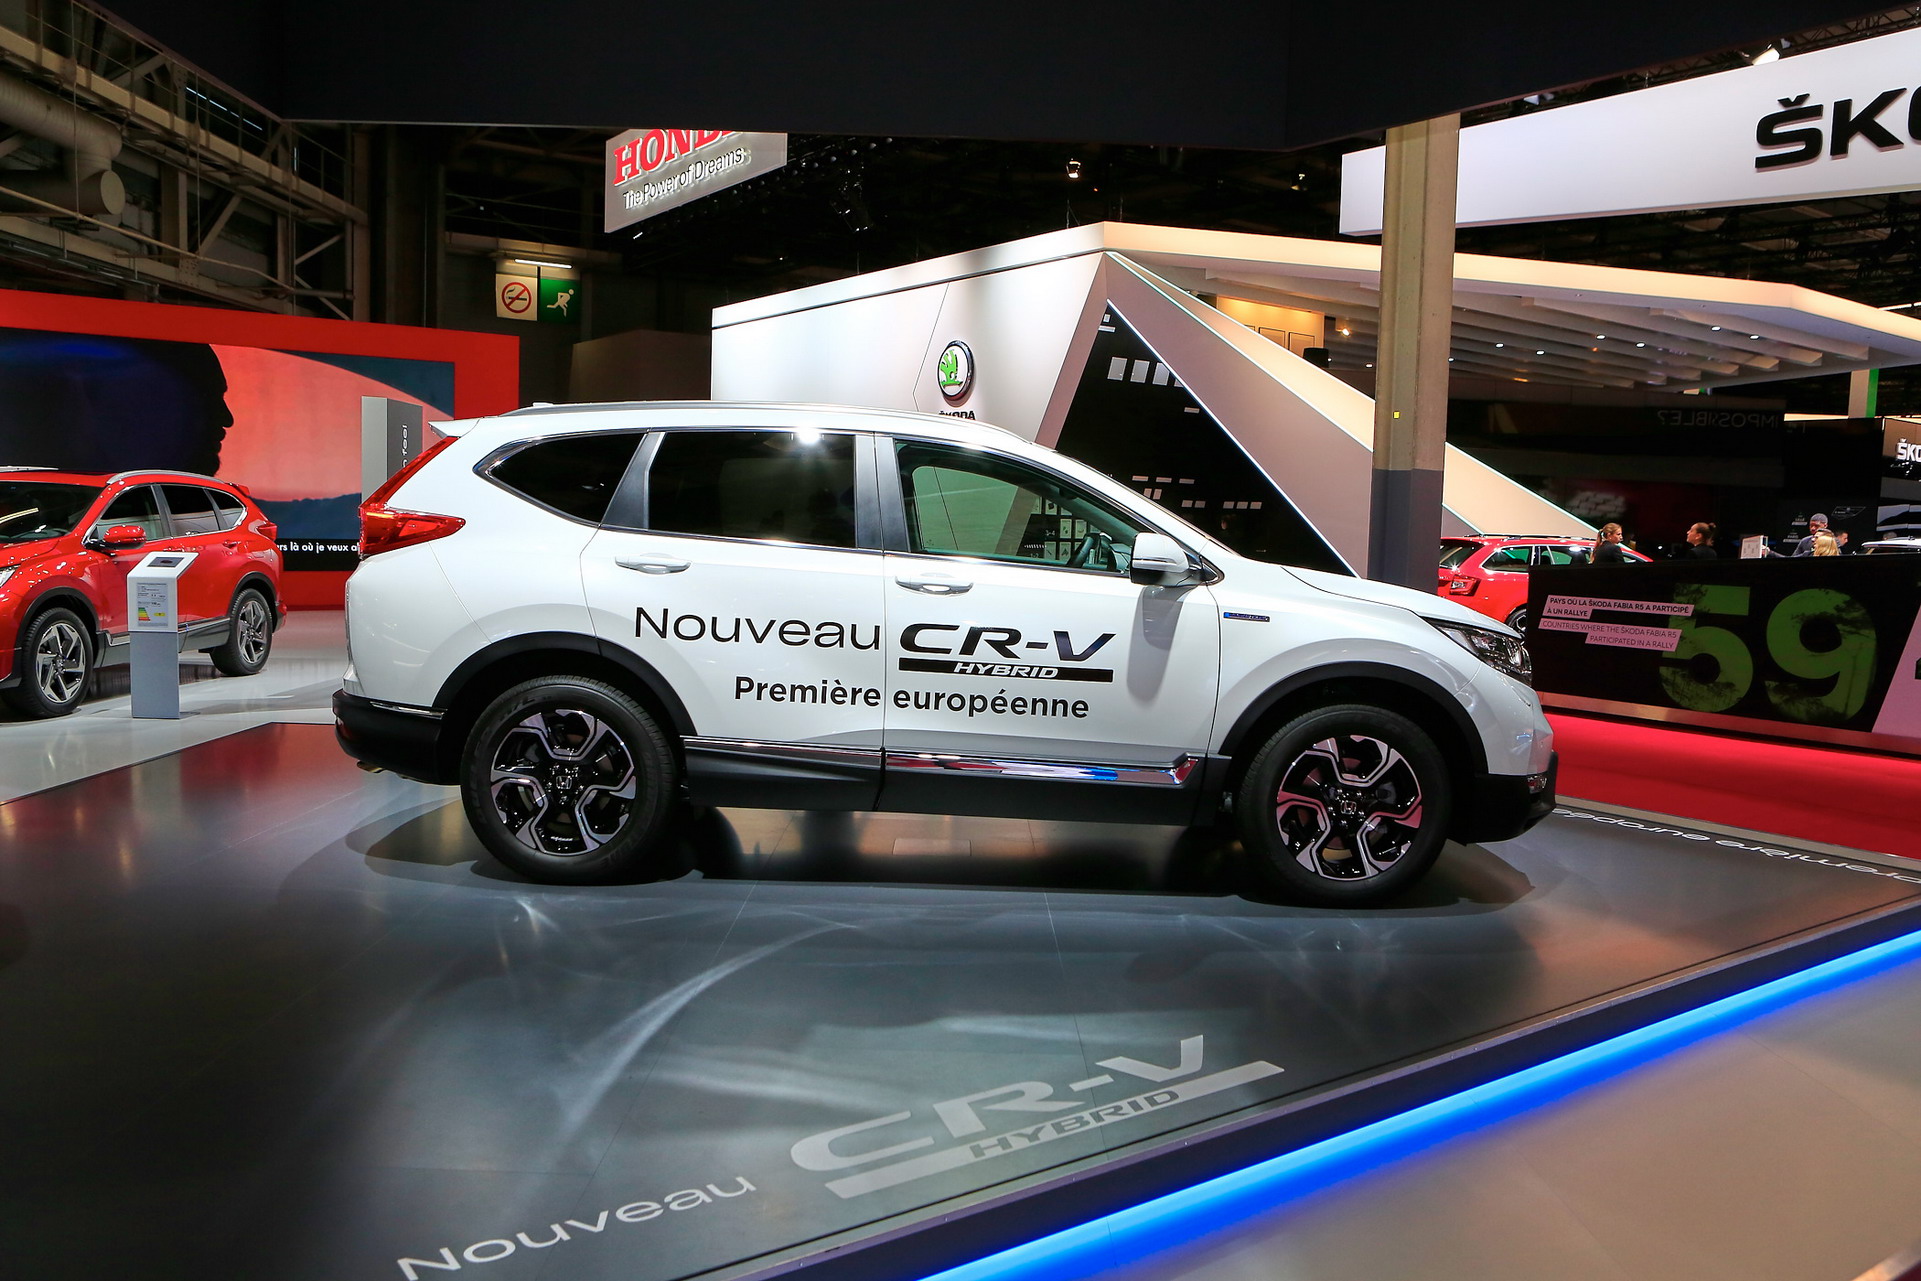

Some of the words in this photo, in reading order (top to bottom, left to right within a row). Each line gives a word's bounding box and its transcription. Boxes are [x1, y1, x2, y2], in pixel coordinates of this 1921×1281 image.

[1755, 86, 1921, 169] ŠK
[613, 129, 742, 185] HON
[623, 188, 643, 209] The
[643, 174, 679, 202] Power
[680, 163, 696, 186] of
[694, 147, 746, 181] Dreams
[290, 541, 299, 551] là
[302, 542, 313, 551] où
[316, 542, 325, 554] je
[1542, 621, 1579, 630] COUNTRIES
[1581, 624, 1605, 632] WHERE
[1620, 626, 1645, 635] ŠKODA
[1646, 629, 1666, 637] FABIA
[1550, 597, 1566, 605] PAYS
[1588, 599, 1612, 608] ŠKODA
[1613, 602, 1633, 610] FABIA
[1652, 604, 1689, 613] PARTICIPÉ
[635, 607, 880, 650] Nouveau
[900, 623, 1117, 662] CR-V
[1590, 635, 1636, 645] PARTICIPATED
[1652, 641, 1674, 649] RALLY
[954, 662, 1058, 678] HYBRID
[735, 676, 881, 706] Première
[893, 688, 1089, 718] européenne
[969, 1090, 1180, 1159] HYBRID
[397, 1176, 756, 1281] Nouveau
[790, 1035, 1204, 1171] CR-V
